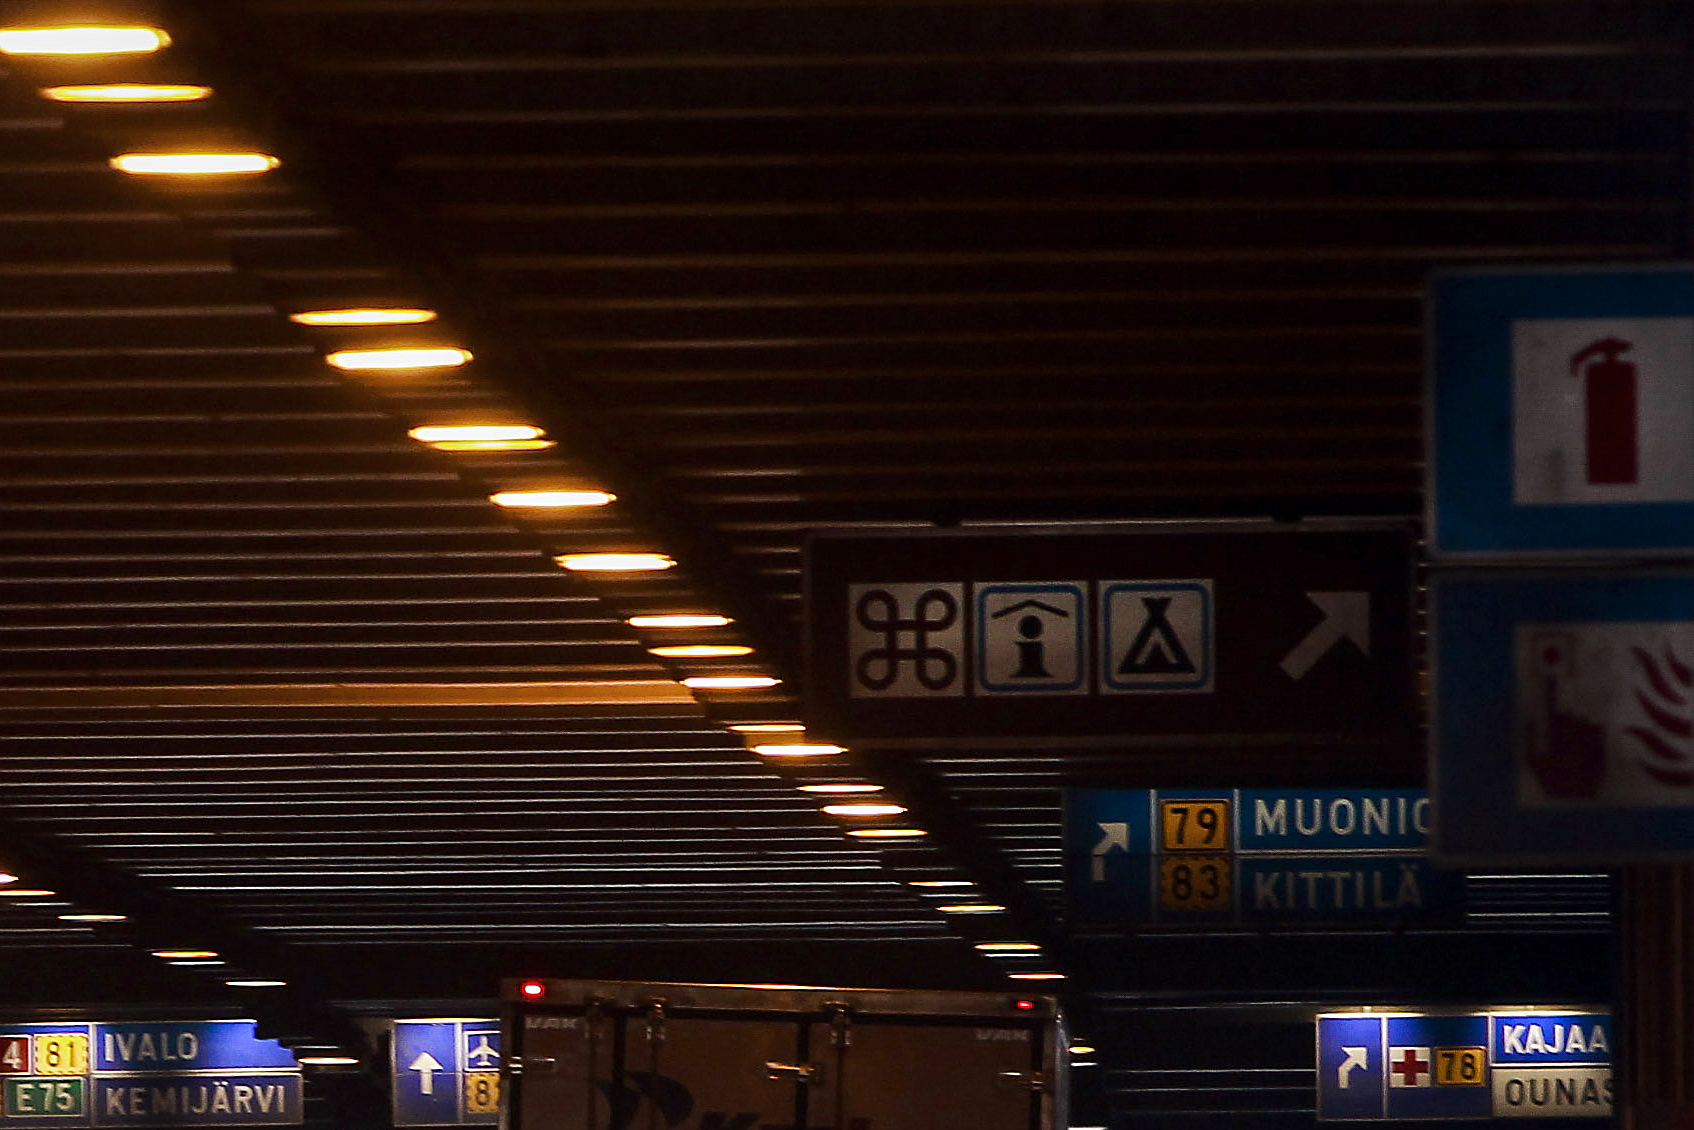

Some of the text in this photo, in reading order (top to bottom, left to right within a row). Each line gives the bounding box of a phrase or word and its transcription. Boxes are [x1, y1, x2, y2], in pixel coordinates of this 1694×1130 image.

[1173, 807, 1217, 846] 79
[1173, 863, 1424, 911] 83 KITTILÄ
[1, 1031, 199, 1070] 4 81 IVALO
[1503, 1023, 1610, 1055] KAJAA
[1441, 1052, 1476, 1081] 78
[15, 1082, 74, 1113] E75
[105, 1080, 286, 1116] KEMIJÄRVI
